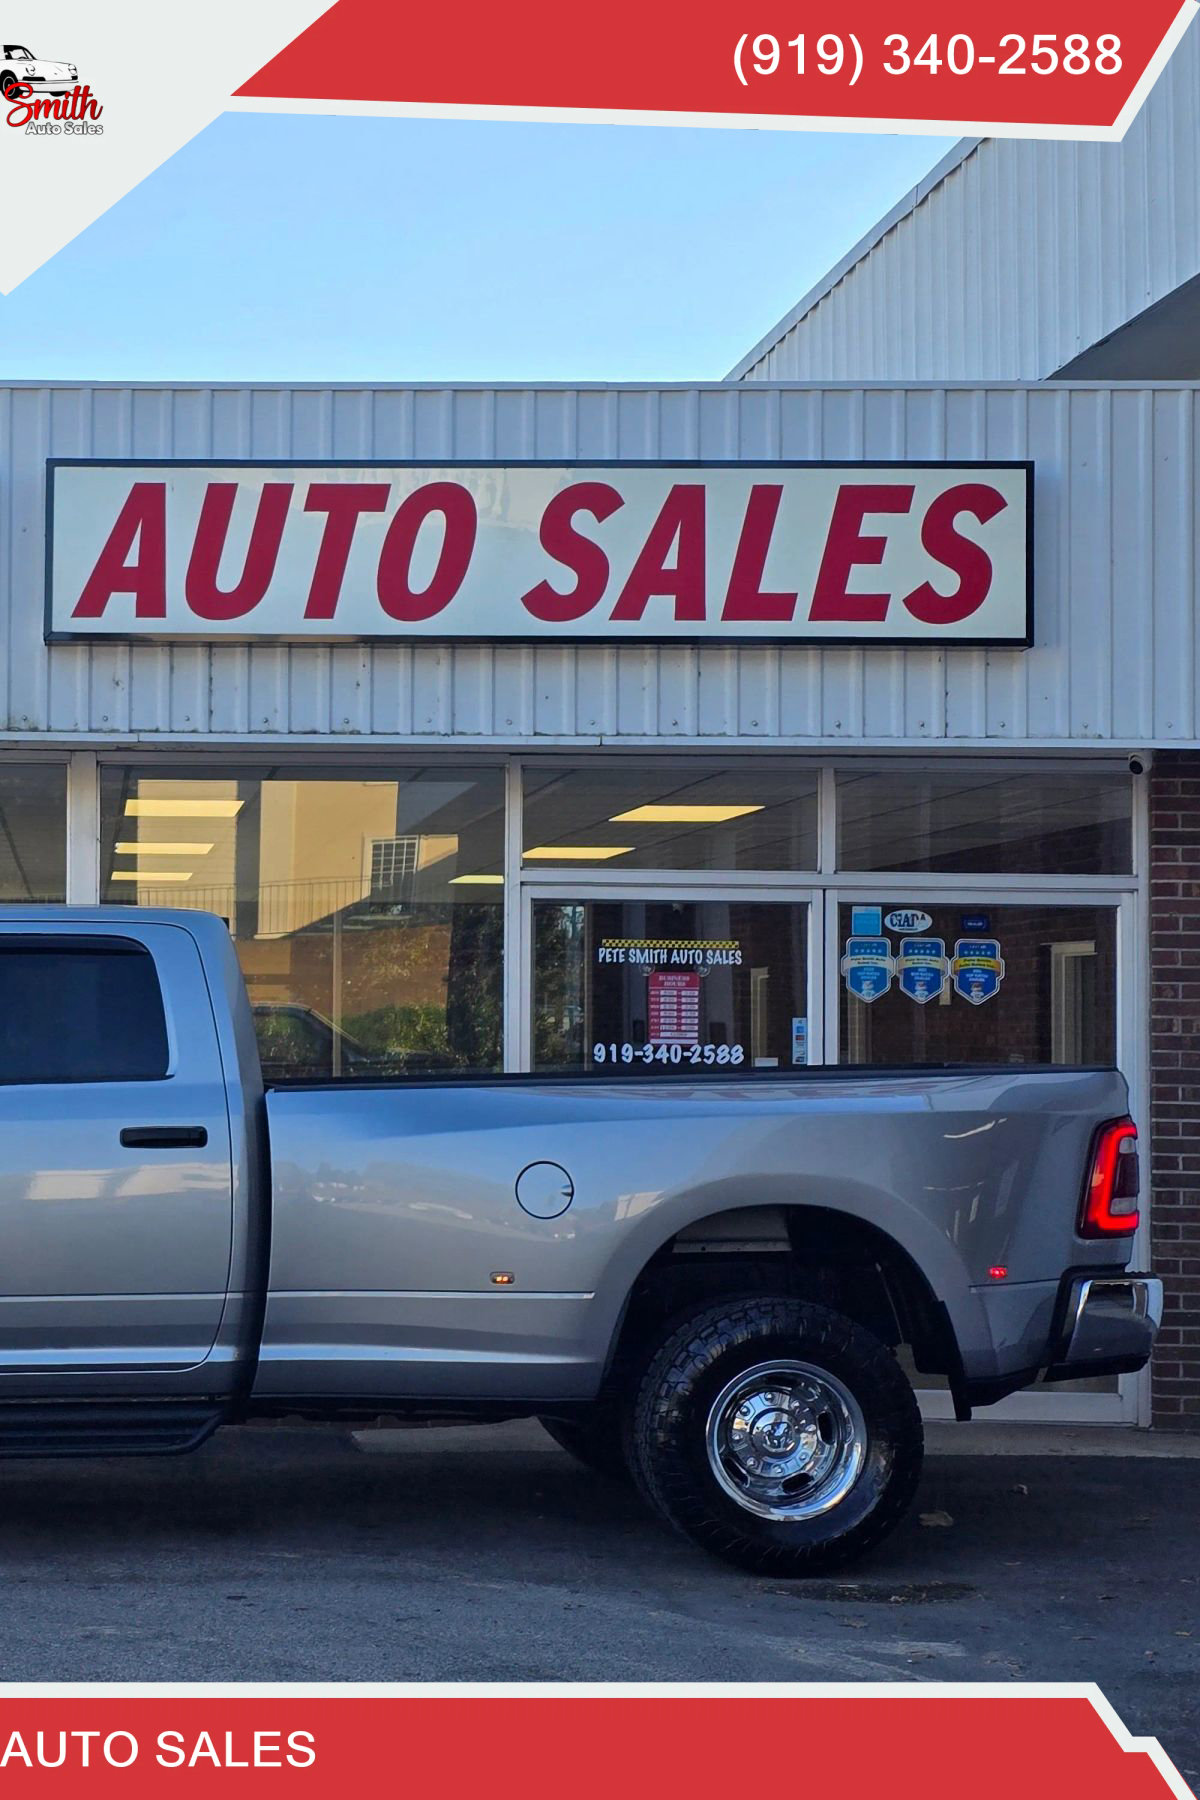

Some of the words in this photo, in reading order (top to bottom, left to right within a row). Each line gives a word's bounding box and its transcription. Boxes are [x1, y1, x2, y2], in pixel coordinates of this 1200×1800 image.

[71, 482, 477, 621] AUTO
[520, 482, 1009, 622] SALES
[598, 948, 625, 963] PETE
[628, 949, 667, 964] SMITH
[670, 950, 703, 964] AUTO
[705, 950, 742, 965] SALES
[593, 1043, 745, 1065] 919-340-2588
